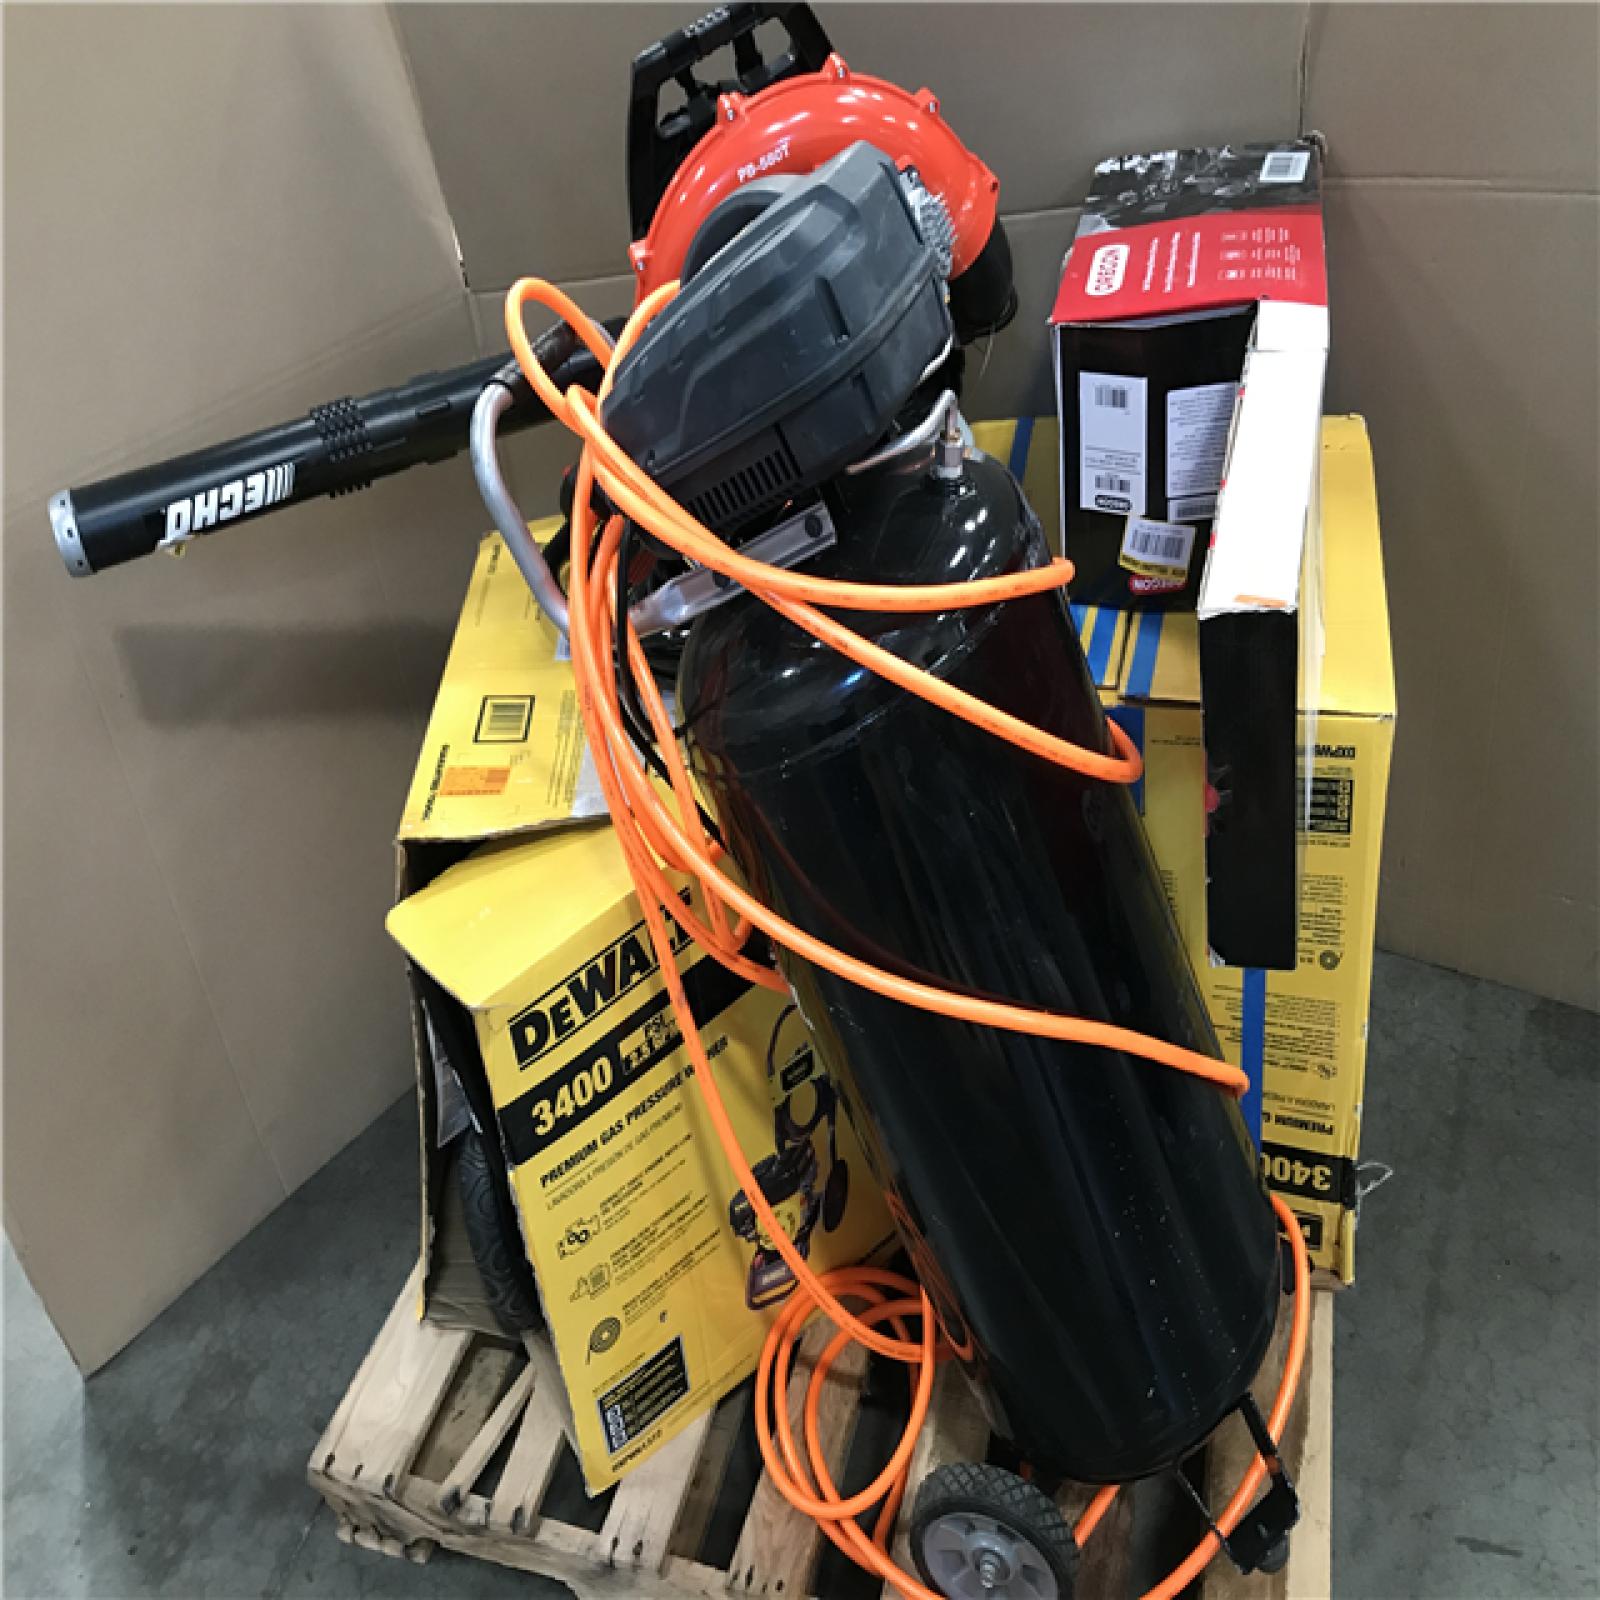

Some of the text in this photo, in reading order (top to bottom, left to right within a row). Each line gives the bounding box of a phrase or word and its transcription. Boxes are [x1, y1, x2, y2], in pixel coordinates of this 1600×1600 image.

[163, 470, 264, 541] ECHO
[532, 1056, 613, 1136] 3400
[540, 1139, 598, 1188] PREMIUM
[600, 1120, 624, 1146] GAS
[625, 1075, 684, 1126] PRESSURE
[684, 1034, 729, 1081] WHER
